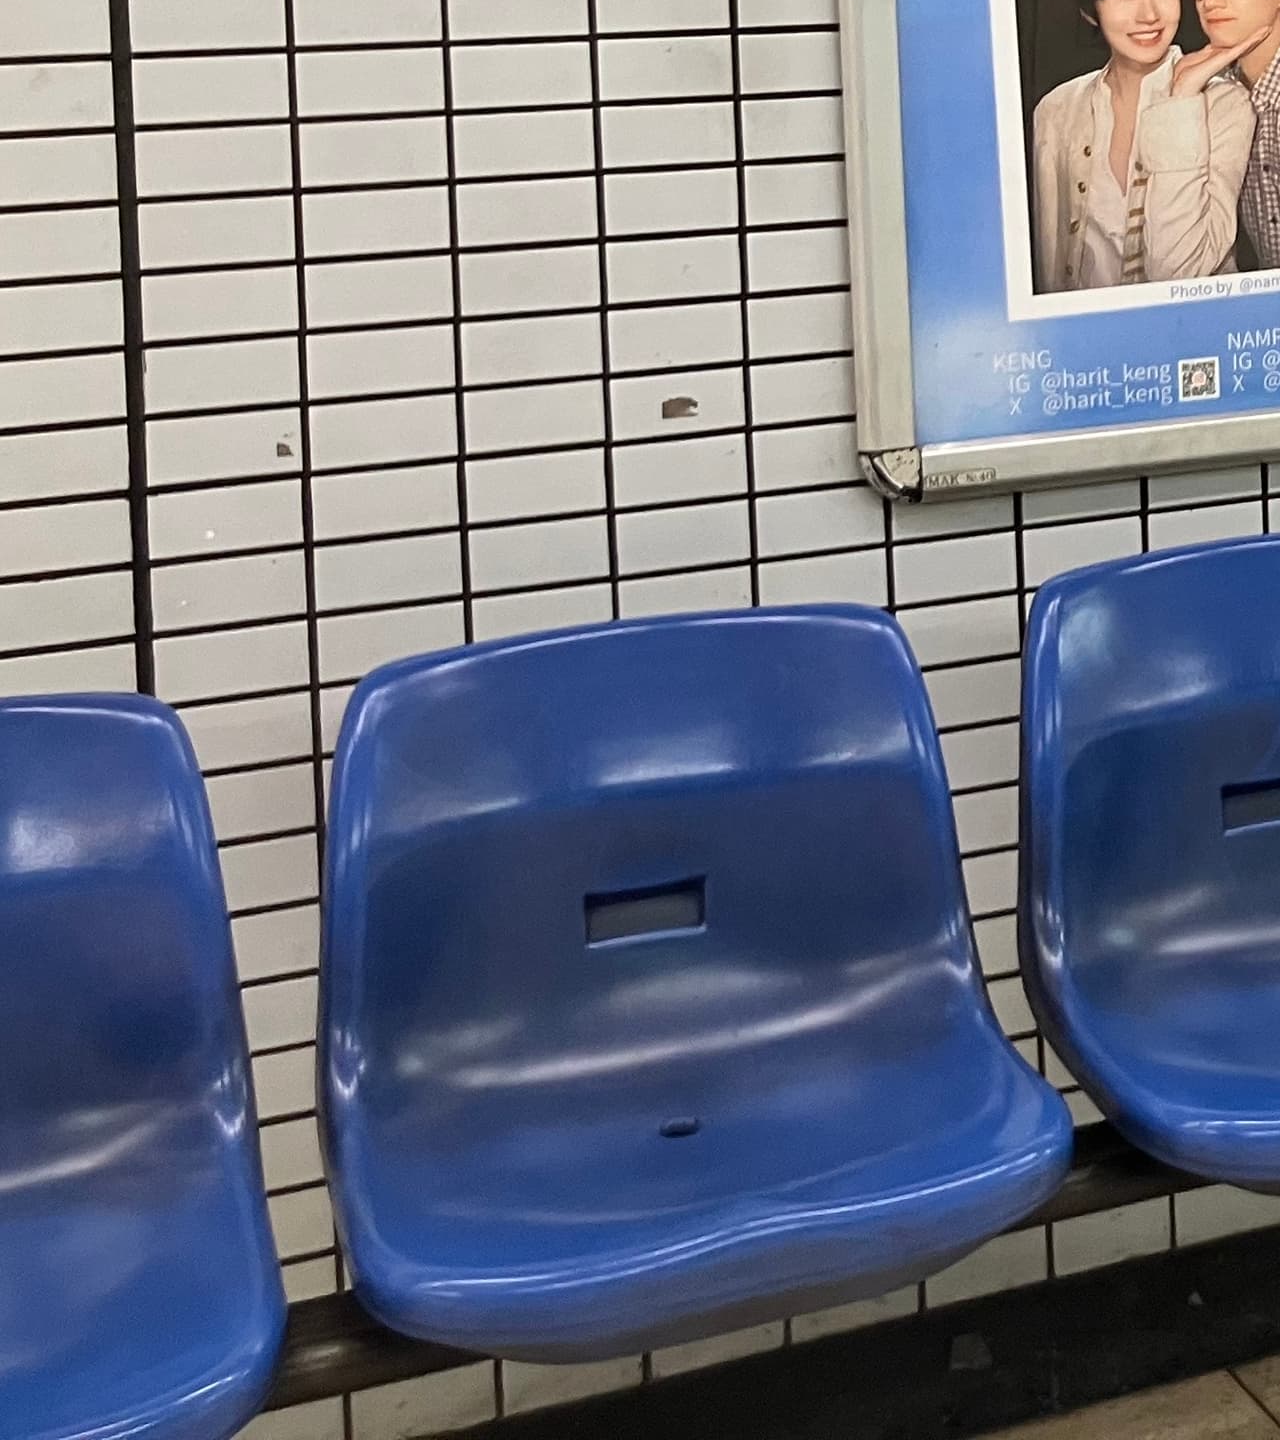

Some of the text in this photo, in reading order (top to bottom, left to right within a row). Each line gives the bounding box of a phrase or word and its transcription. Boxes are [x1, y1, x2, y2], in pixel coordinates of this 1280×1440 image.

[1170, 281, 1212, 299] Photo
[1216, 280, 1233, 297] by
[993, 349, 1052, 372] KENG
[1233, 353, 1252, 372] IG
[1010, 363, 1172, 394] IG @harit_keng
[1232, 375, 1245, 392] X
[1009, 385, 1173, 415] X @harit_keng
